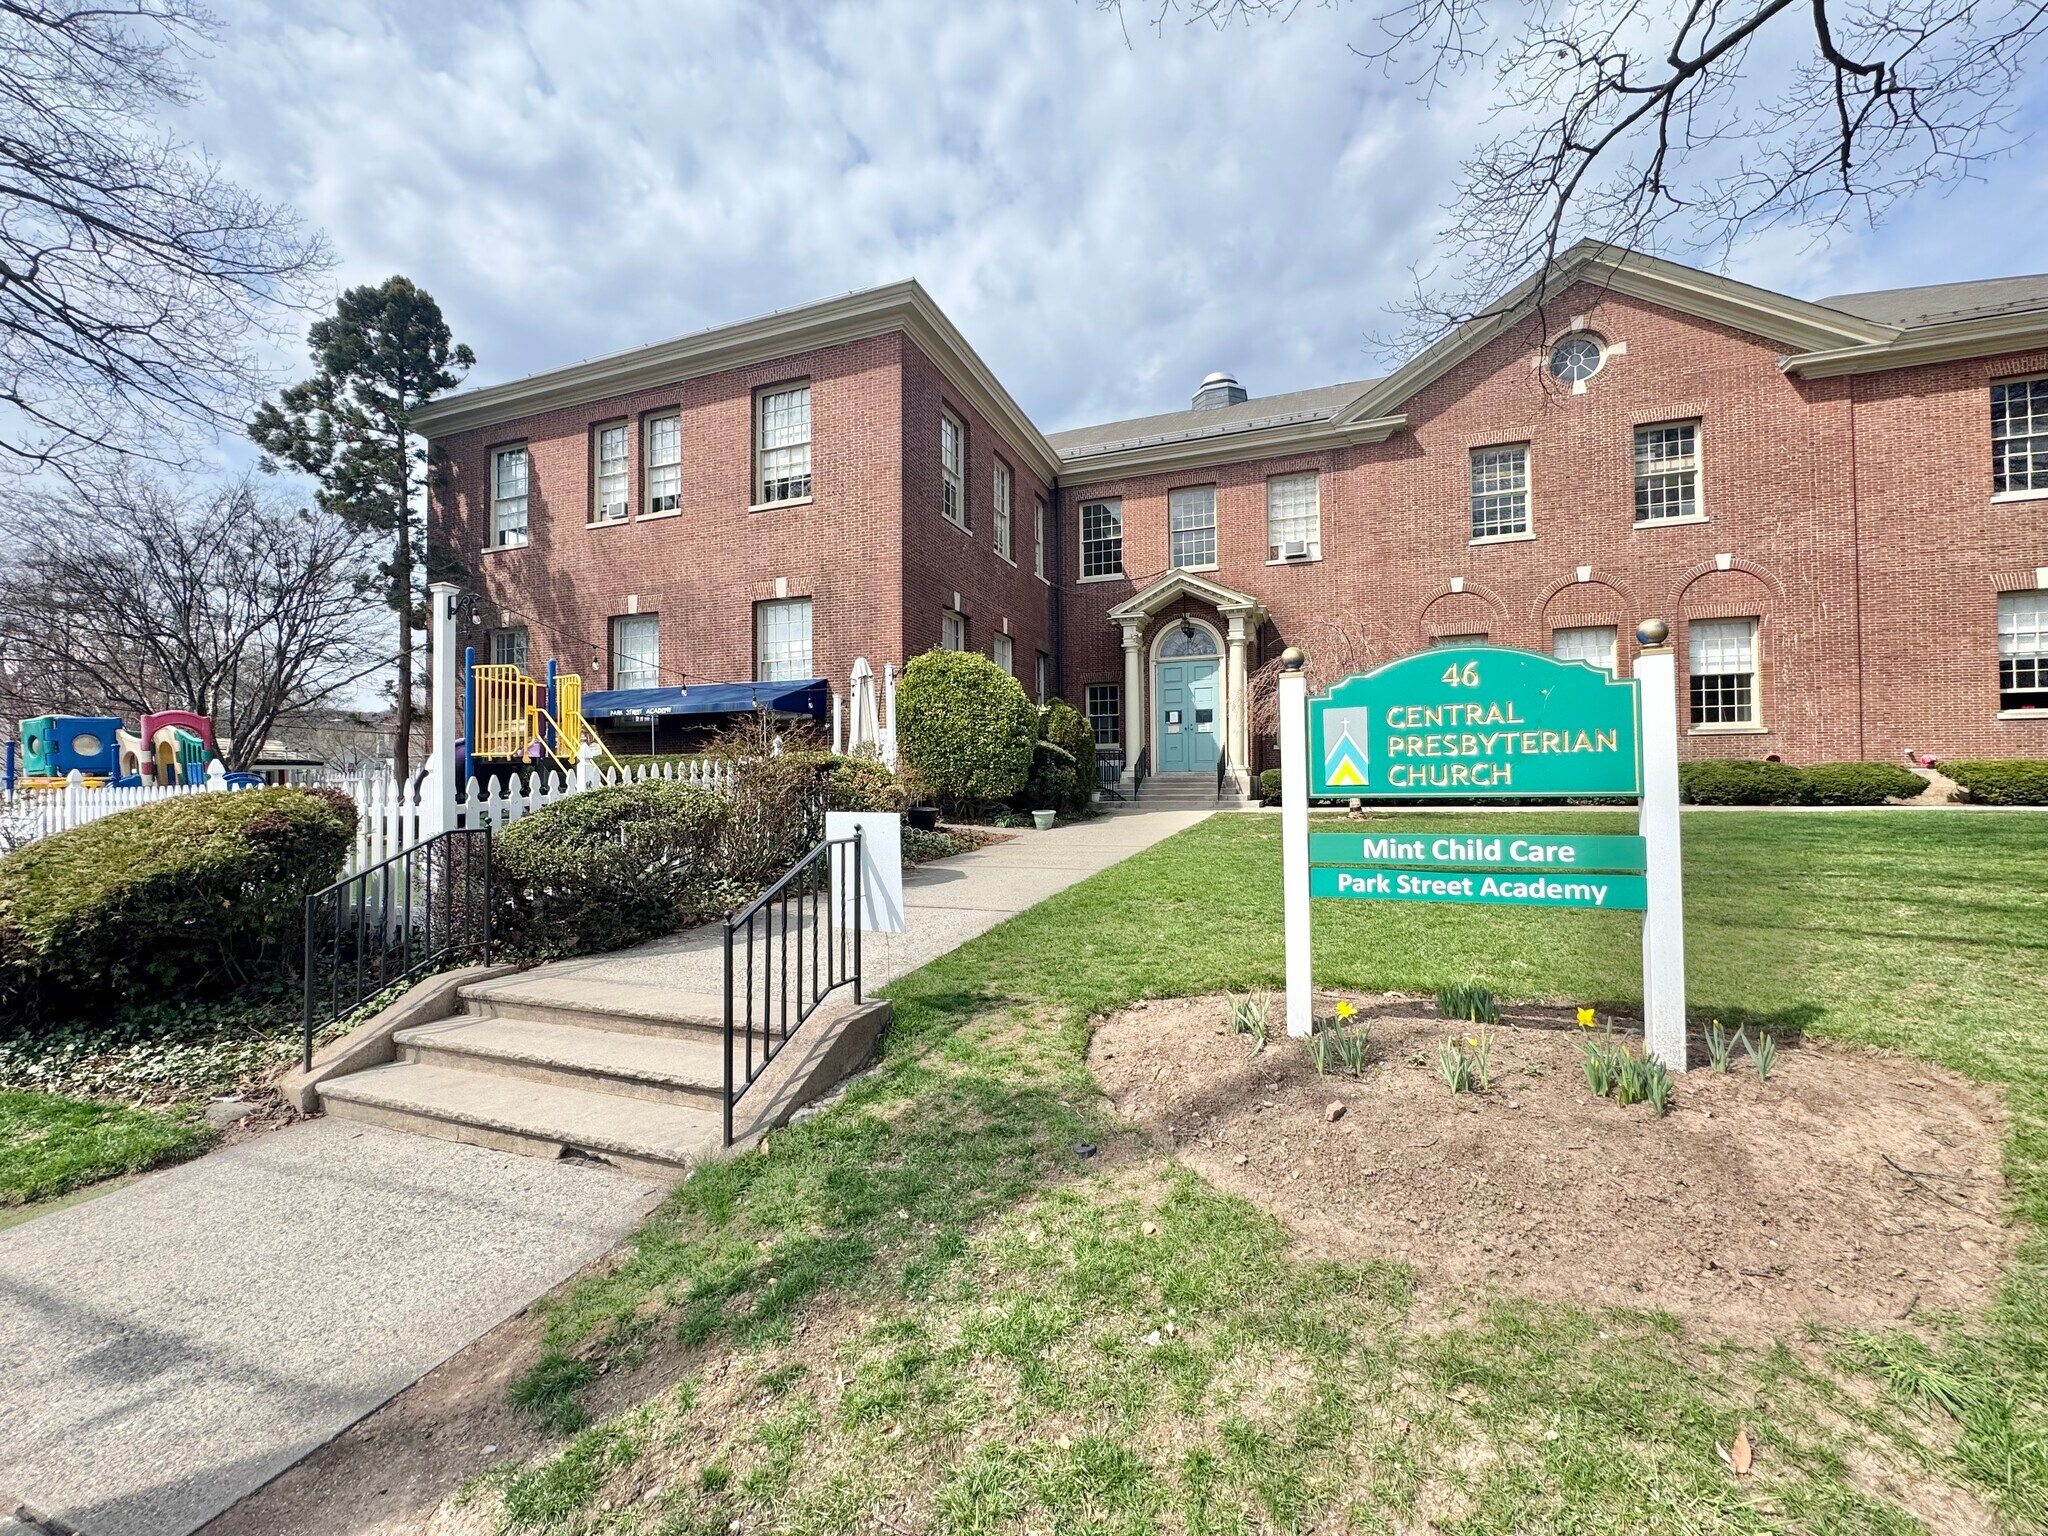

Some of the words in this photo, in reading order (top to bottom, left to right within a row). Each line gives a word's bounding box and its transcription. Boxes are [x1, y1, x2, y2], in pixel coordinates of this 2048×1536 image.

[1441, 661, 1479, 687] 46
[626, 708, 643, 716] STREET
[1386, 702, 1524, 729] CENTRAL
[1388, 729, 1618, 757] PRESBYTERIAN
[1388, 763, 1512, 787] CHURCH
[1363, 839, 1424, 860] Mint
[1432, 839, 1500, 862] Child
[1509, 840, 1575, 862] Care
[1338, 873, 1390, 893] Park
[1397, 875, 1473, 896] Street
[1480, 877, 1607, 905] Academy
